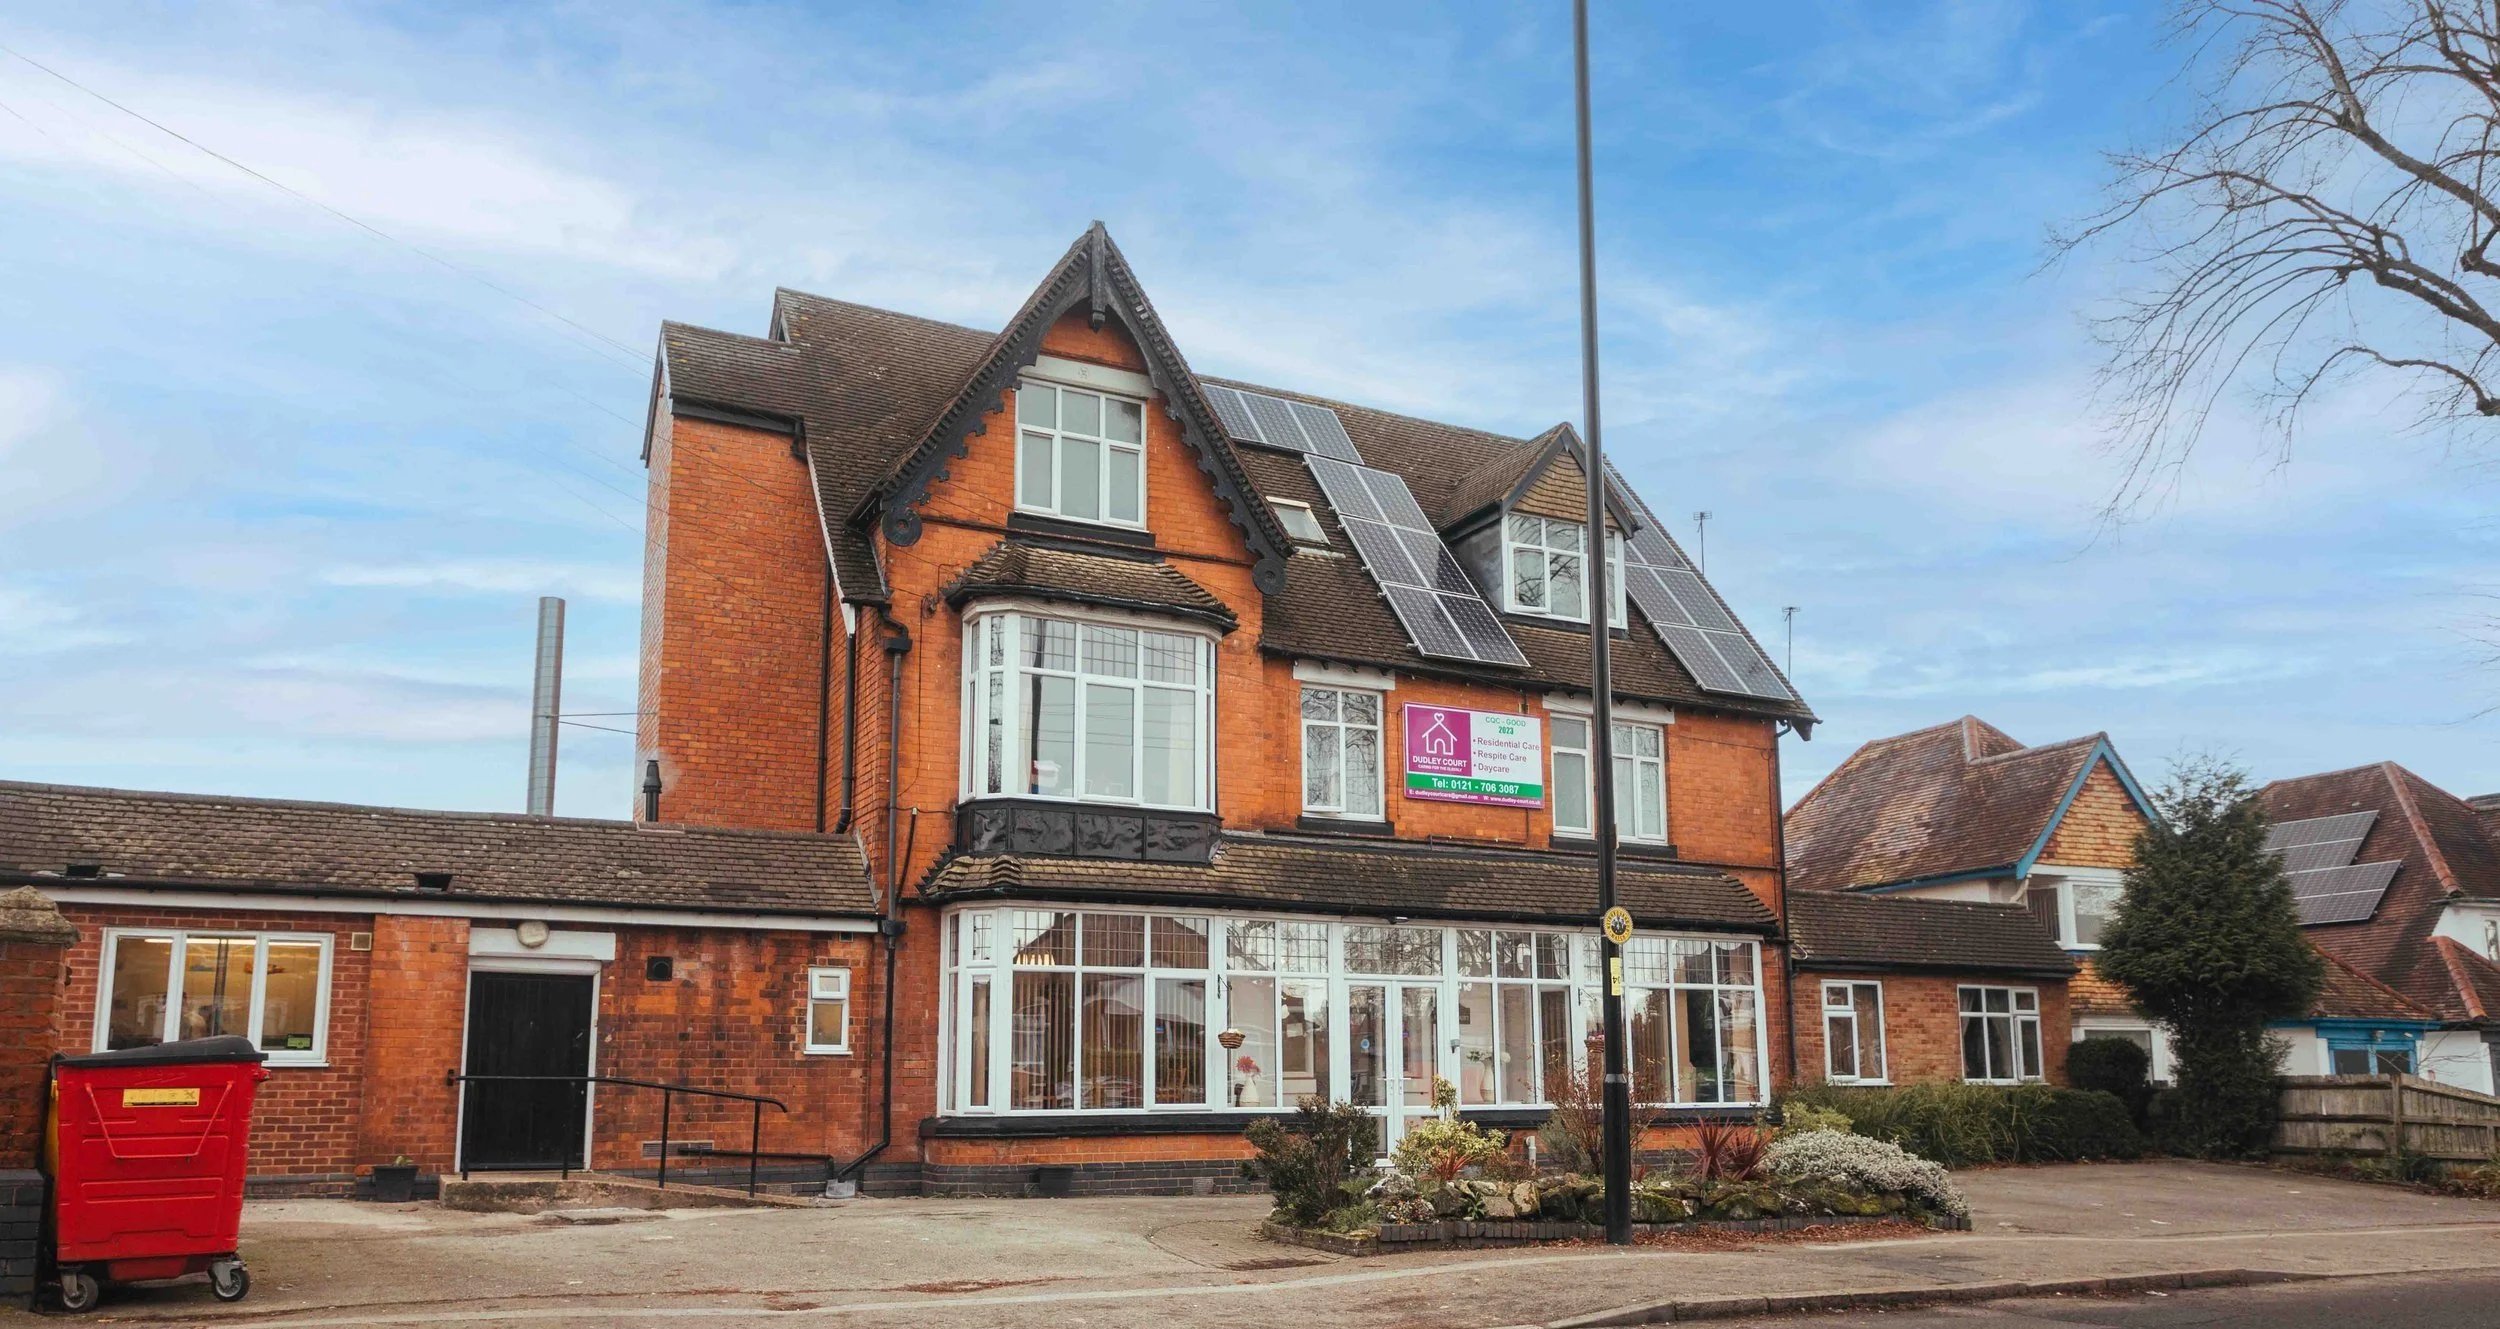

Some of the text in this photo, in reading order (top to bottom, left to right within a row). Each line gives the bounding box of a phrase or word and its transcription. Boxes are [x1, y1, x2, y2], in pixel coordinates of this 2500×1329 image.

[1485, 716, 1500, 724] CQC
[1506, 718, 1526, 727] GOOD
[1498, 726, 1514, 735] 2023
[1477, 737, 1540, 751] Residential Care
[1412, 755, 1467, 768] DUDLEY COURT
[1477, 750, 1527, 762] Respite Care
[1478, 763, 1510, 774] Daycare
[1432, 777, 1449, 789] Tel:
[1451, 779, 1472, 791] 0121
[1480, 782, 1497, 792] 706
[1499, 784, 1519, 794] 3087
